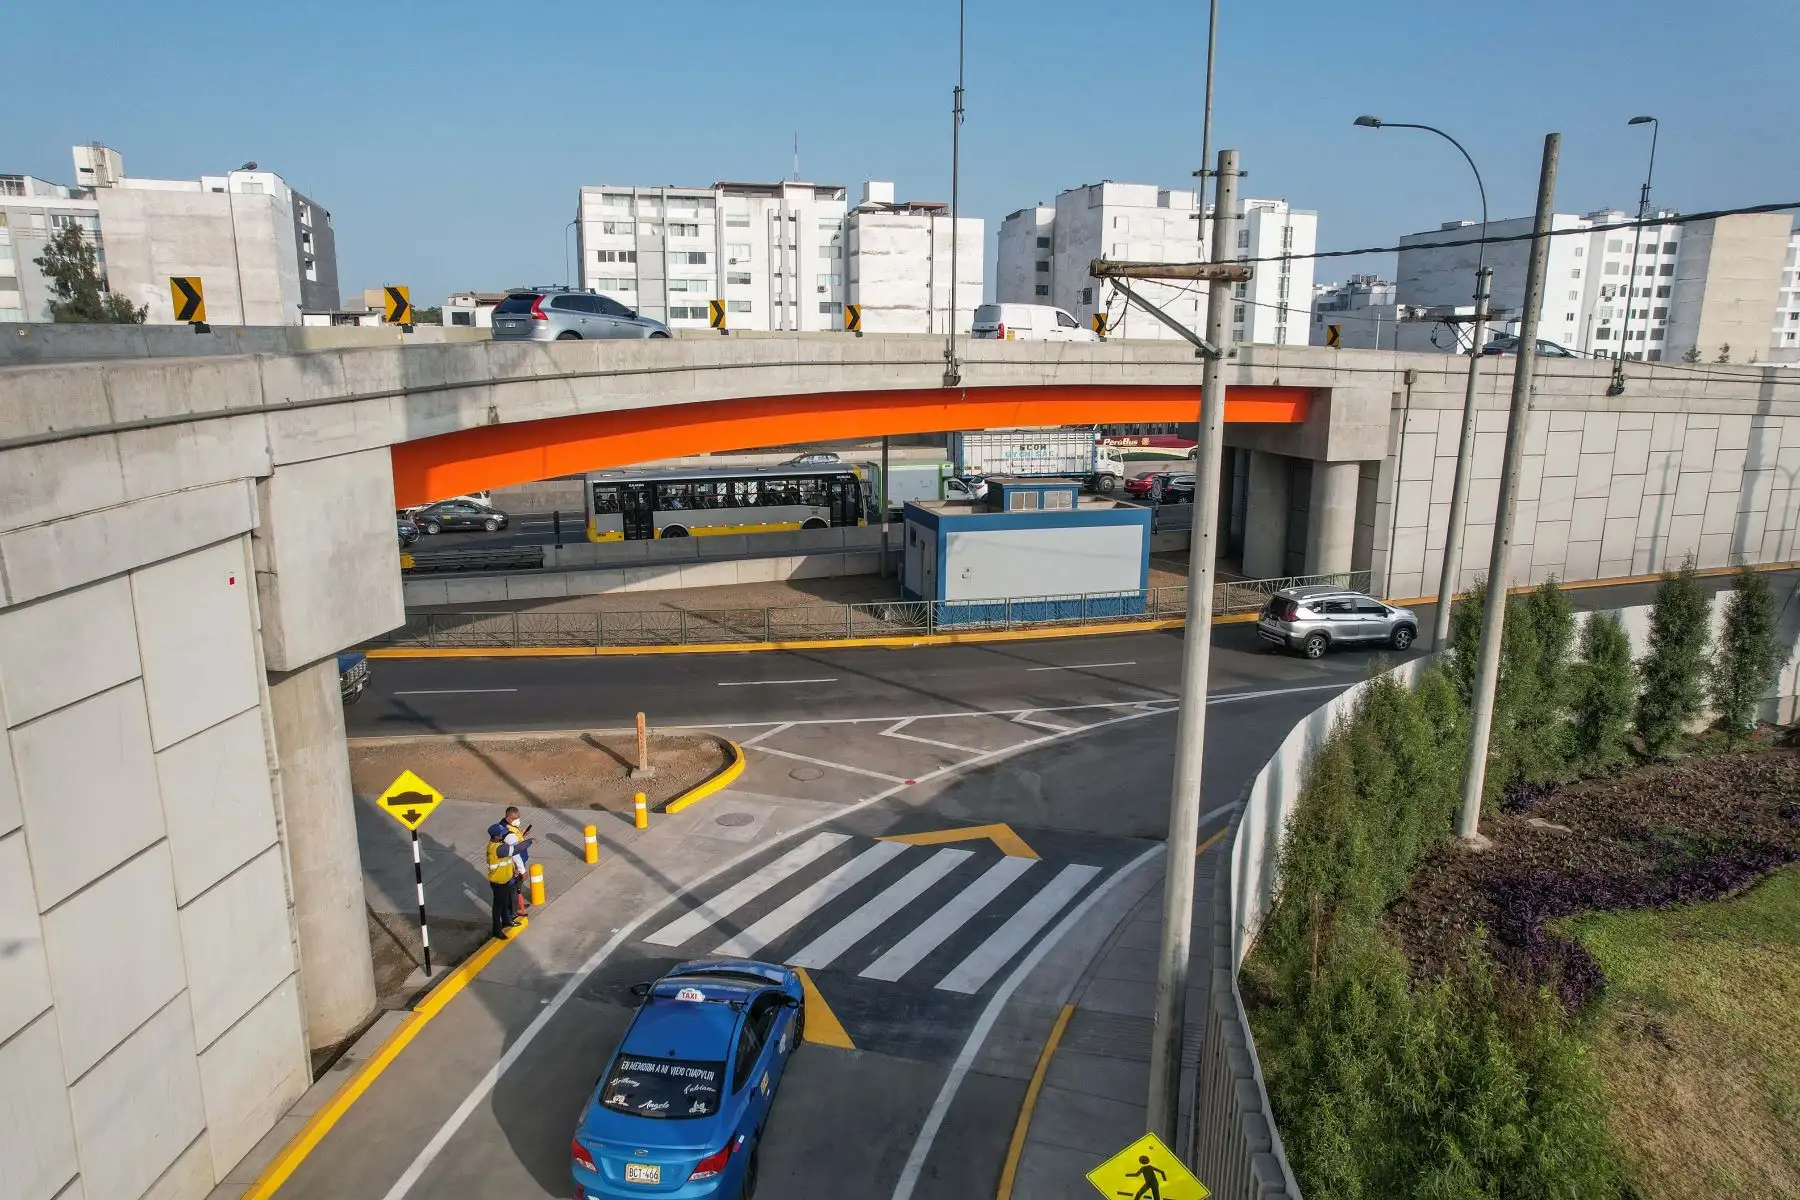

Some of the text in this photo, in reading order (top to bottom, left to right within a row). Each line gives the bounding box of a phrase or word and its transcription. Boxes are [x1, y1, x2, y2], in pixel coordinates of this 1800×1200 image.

[682, 992, 697, 1000] TAXI
[638, 1100, 670, 1110] Angelo
[629, 1167, 659, 1179] BCT-466
